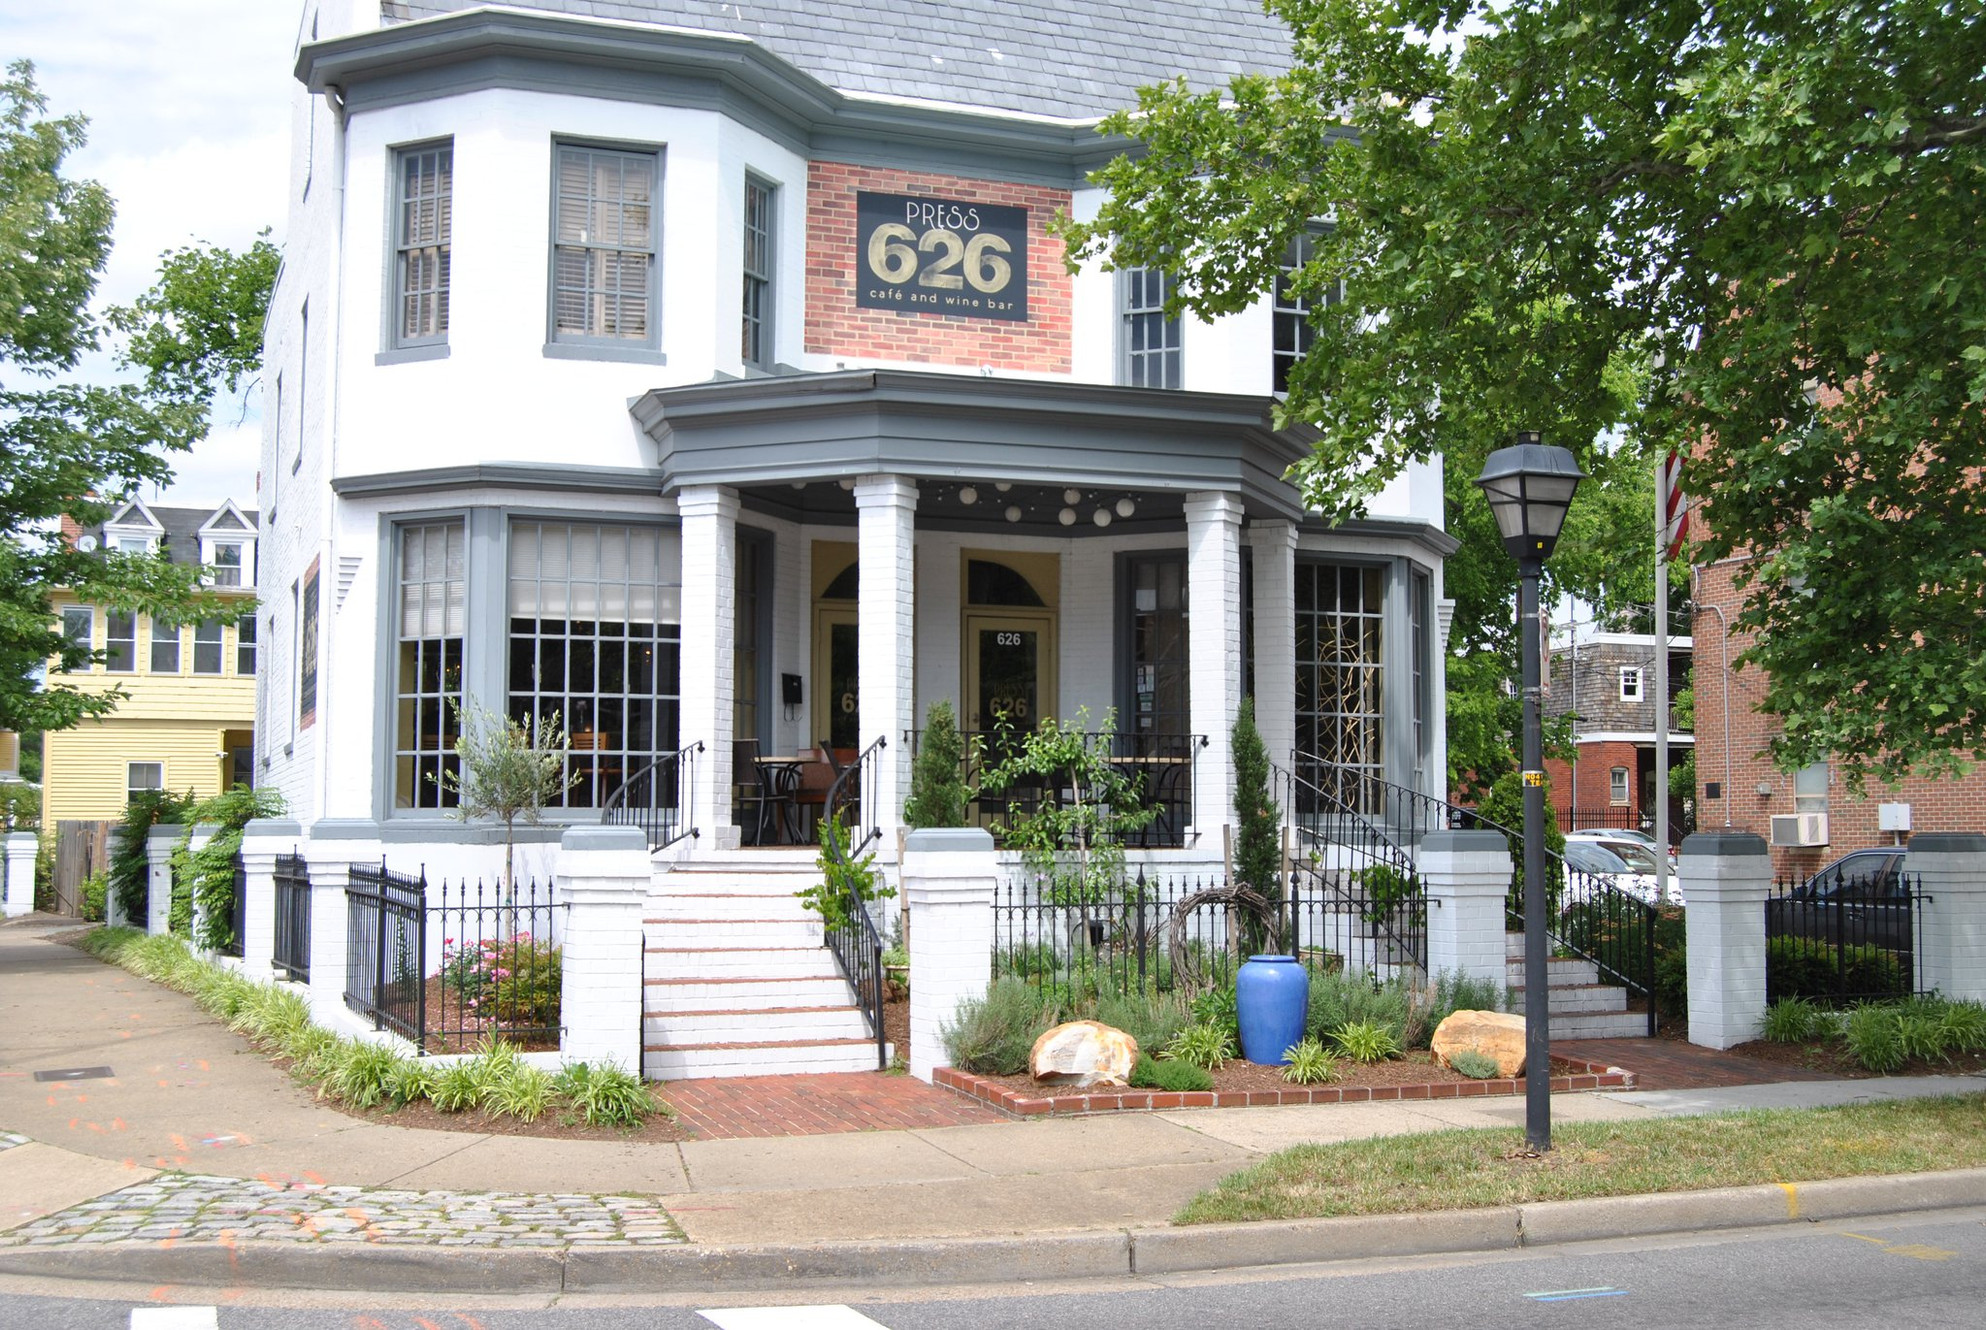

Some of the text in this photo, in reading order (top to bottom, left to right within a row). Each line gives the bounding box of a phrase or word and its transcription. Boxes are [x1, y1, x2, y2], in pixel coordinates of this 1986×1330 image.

[906, 201, 980, 231] PRESS
[868, 222, 1012, 294] 626
[870, 288, 1014, 310] café and wine bar
[997, 632, 1021, 646] 626
[989, 697, 1028, 718] 626
